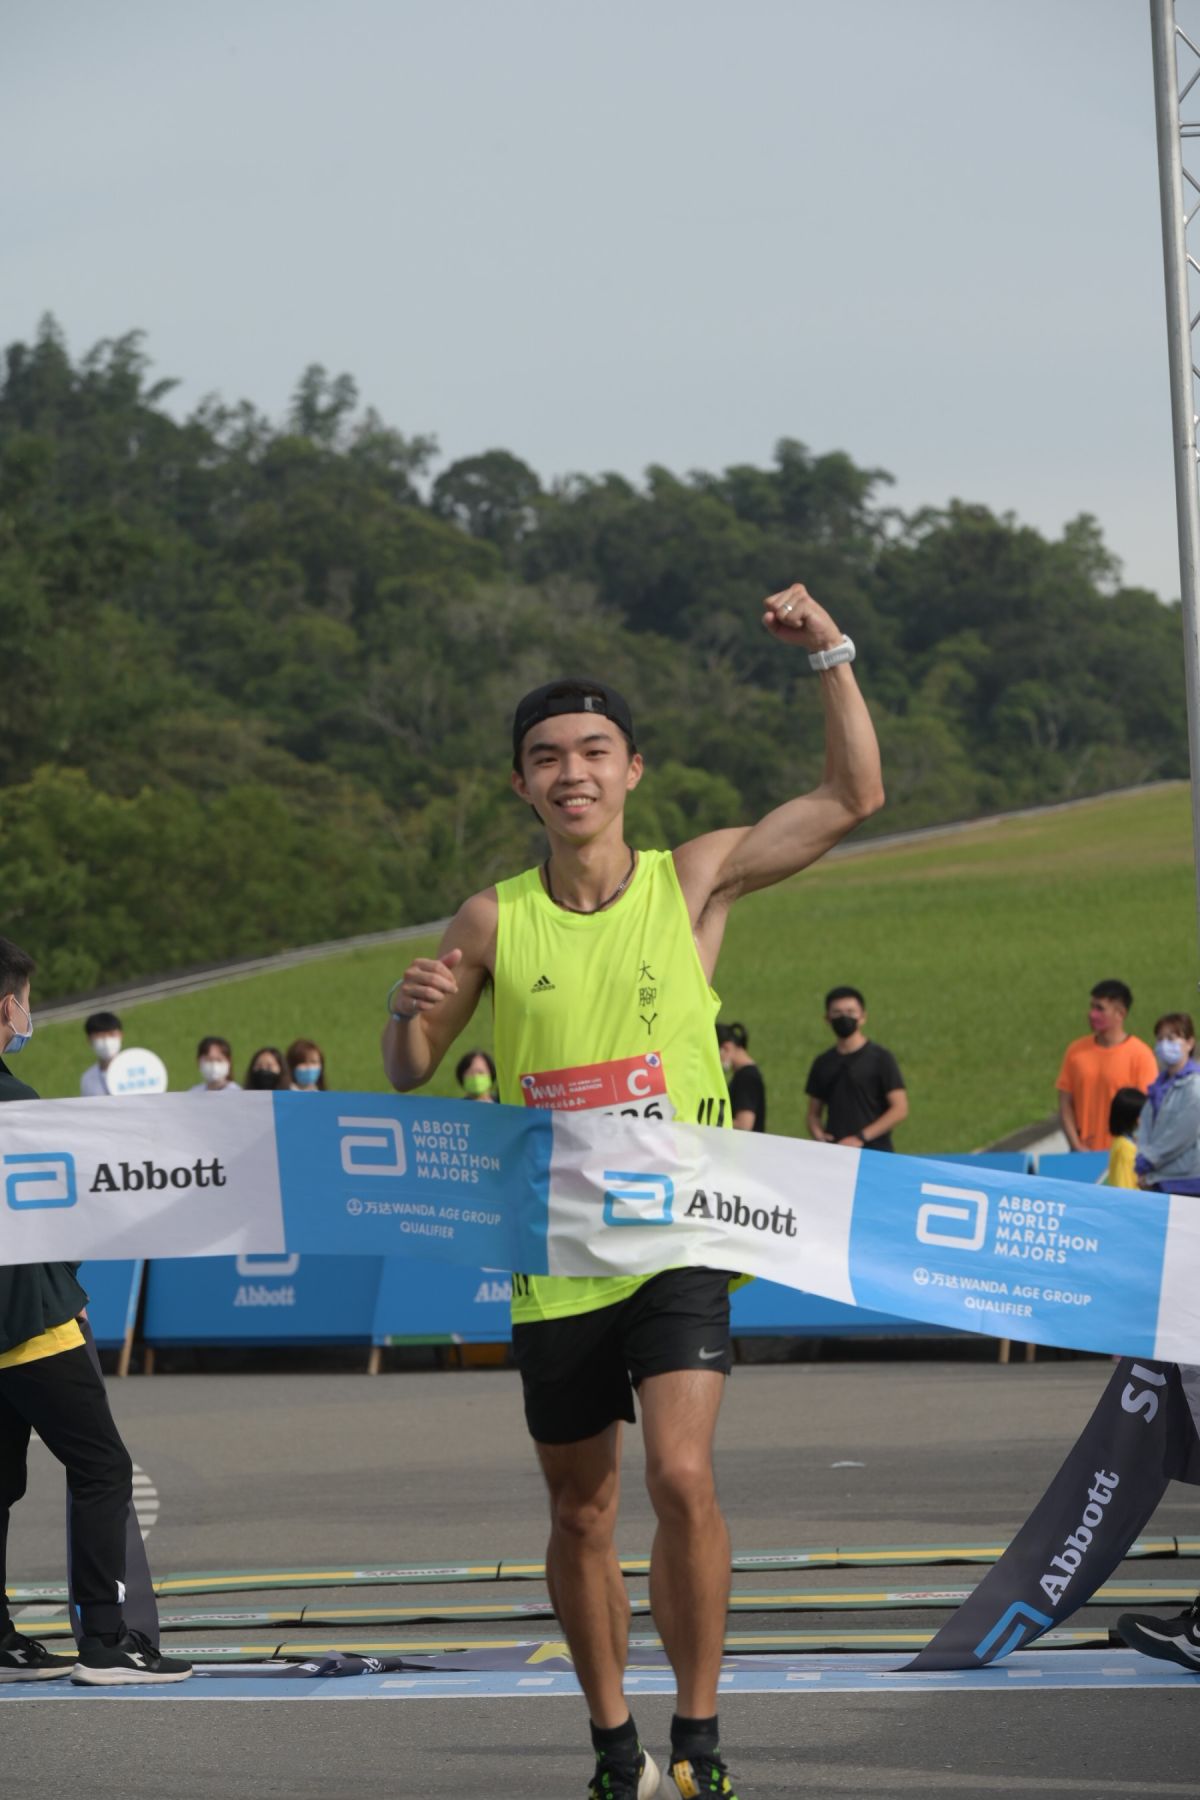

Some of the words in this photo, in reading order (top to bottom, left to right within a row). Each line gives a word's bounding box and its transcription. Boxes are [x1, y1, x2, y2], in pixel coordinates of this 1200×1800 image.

[627, 1069, 651, 1096] C
[411, 1120, 470, 1137] ABBOTT
[413, 1135, 468, 1151] WORLD
[415, 1151, 500, 1170] MARATHON
[89, 1157, 227, 1193] Abbott
[417, 1165, 479, 1184] MAJORS
[438, 1207, 460, 1221] AGE
[462, 1210, 501, 1226] GROUP
[683, 1189, 797, 1238] Abbott
[998, 1196, 1066, 1216] ABBOTT
[400, 1221, 455, 1239] QUALIFIER
[997, 1210, 1060, 1231] WORLD
[995, 1226, 1099, 1253] MARATHON
[994, 1241, 1067, 1265] MAJORS
[234, 1285, 296, 1305] Abbott
[475, 1282, 512, 1303] Abb
[1012, 1284, 1040, 1300] AGE
[1042, 1288, 1093, 1307] GROUP
[964, 1296, 1033, 1318] QUALIFIER
[1039, 1469, 1120, 1606] Abbott
